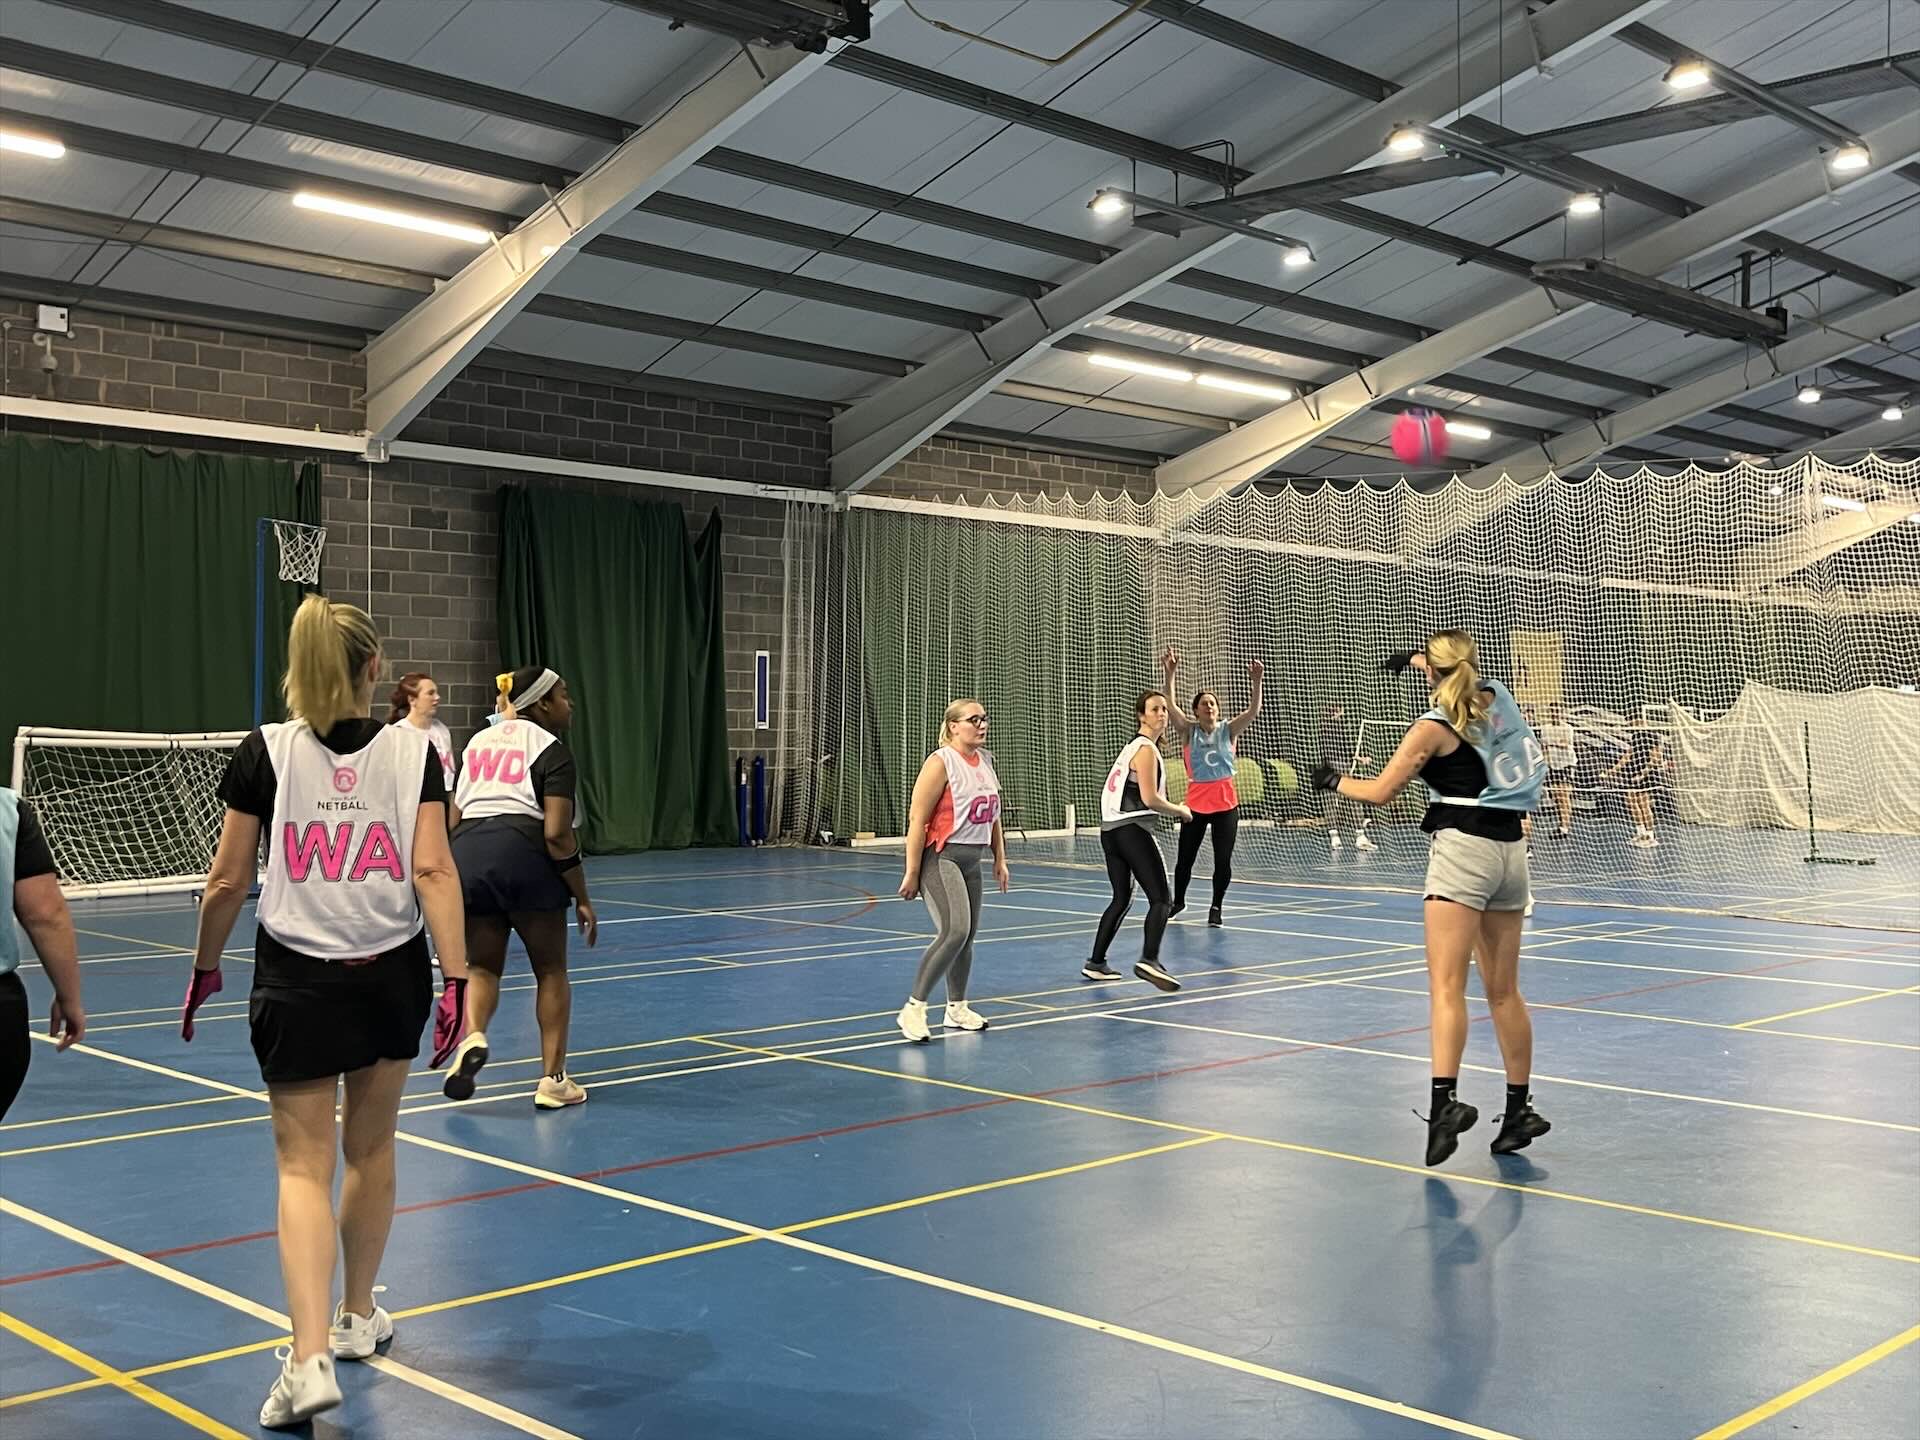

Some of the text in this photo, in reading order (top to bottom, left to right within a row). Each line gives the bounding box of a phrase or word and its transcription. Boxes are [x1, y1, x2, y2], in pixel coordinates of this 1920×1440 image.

[1204, 750, 1220, 767] C
[317, 801, 368, 811] NETBALL
[284, 821, 405, 882] WA
